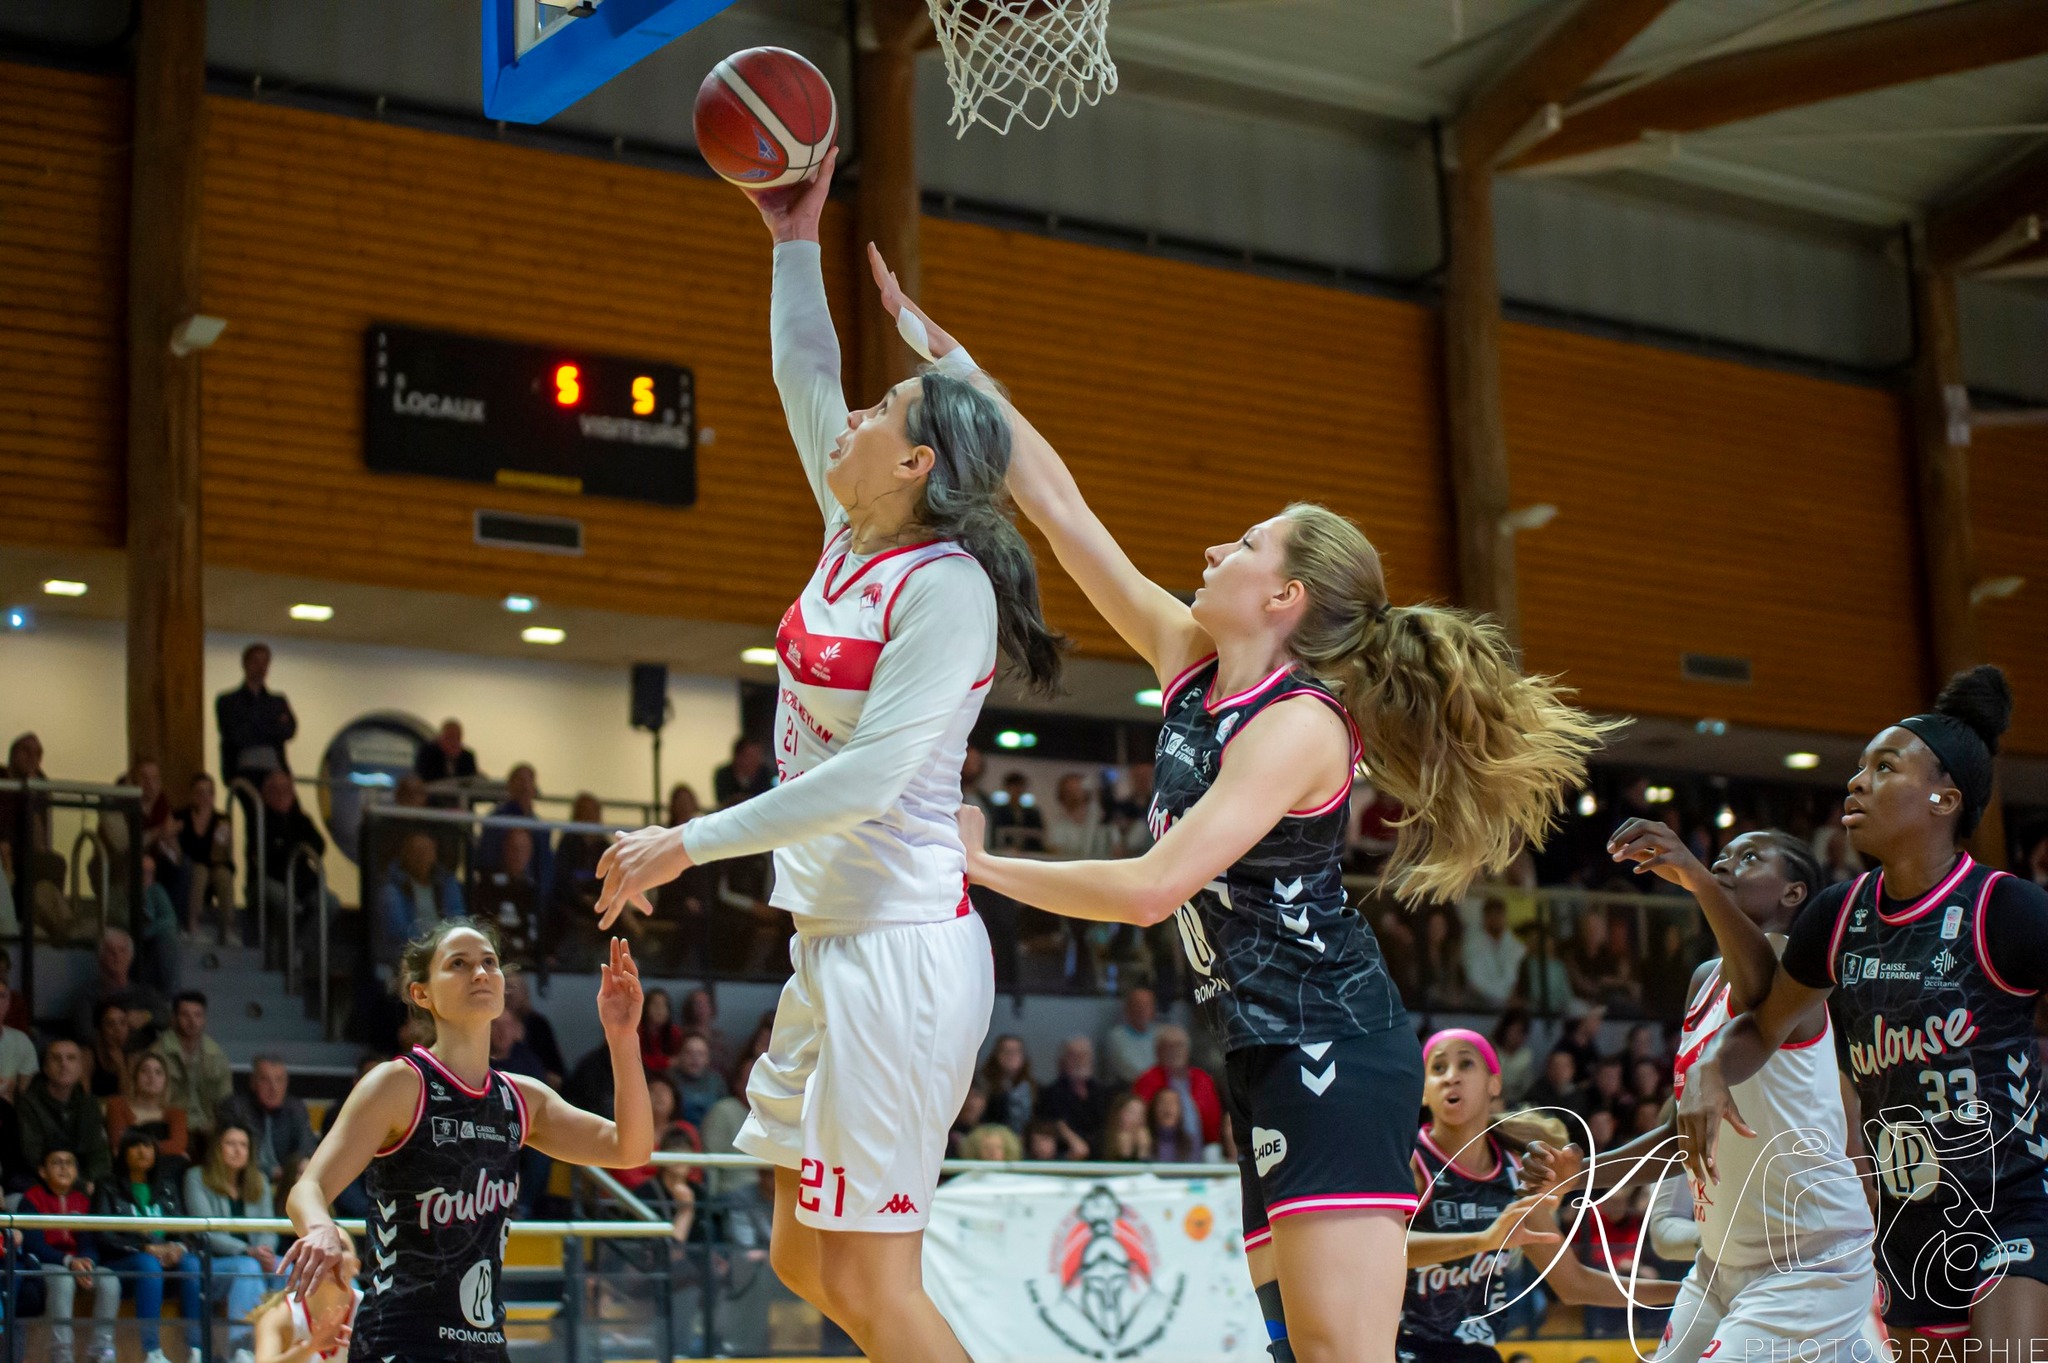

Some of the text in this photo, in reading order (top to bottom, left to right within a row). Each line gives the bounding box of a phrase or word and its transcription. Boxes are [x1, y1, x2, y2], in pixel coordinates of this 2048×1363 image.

[393, 389, 485, 422] LOCAUX
[783, 715, 799, 756] 21
[1879, 971, 1921, 980] D'EPARGNE
[1880, 963, 1907, 971] CAISSE
[1923, 980, 1960, 988] Occitanie
[1918, 1068, 1979, 1123] 33
[415, 1168, 520, 1232] Toulou
[798, 1157, 845, 1217] 21
